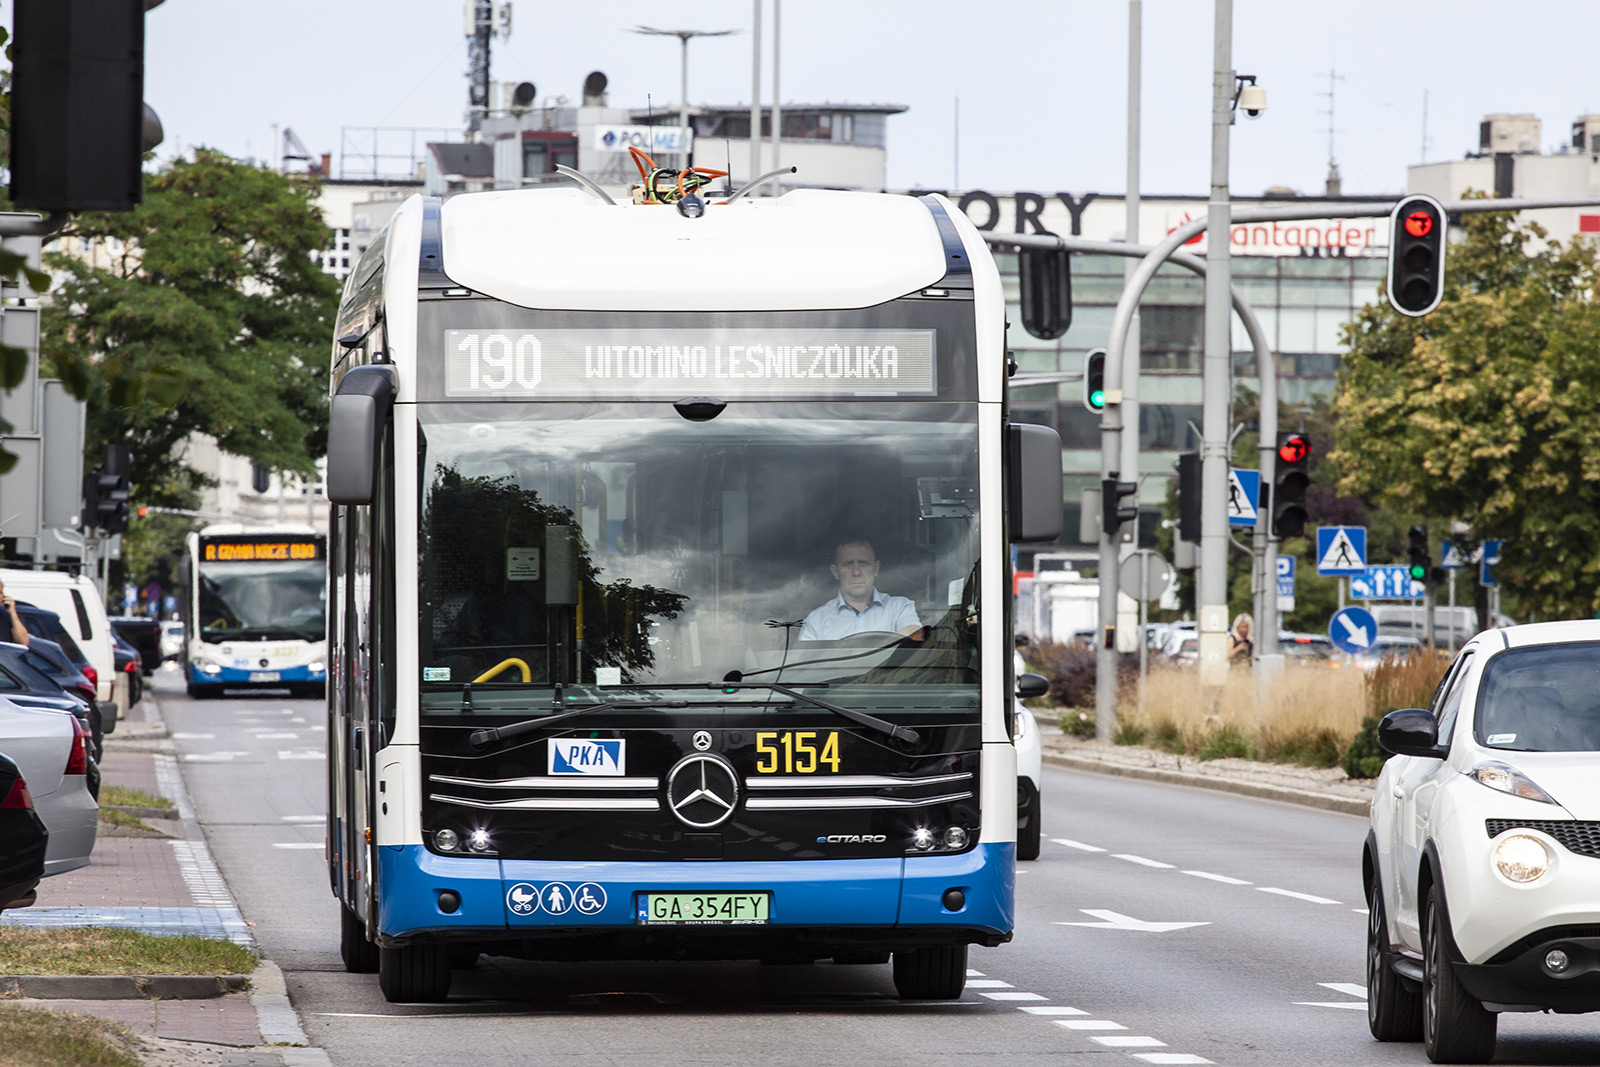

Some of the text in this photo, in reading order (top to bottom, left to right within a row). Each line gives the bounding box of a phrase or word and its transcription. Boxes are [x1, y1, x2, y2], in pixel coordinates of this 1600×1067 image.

[909, 190, 1098, 236] ORY
[1230, 221, 1376, 248] antander
[458, 334, 898, 389] 190 WITOMINO LEŚNICZÓWKA
[568, 745, 604, 765] PKA
[756, 731, 841, 773] 5154
[816, 834, 887, 844] eCITARO
[654, 896, 762, 918] GA 354FY
